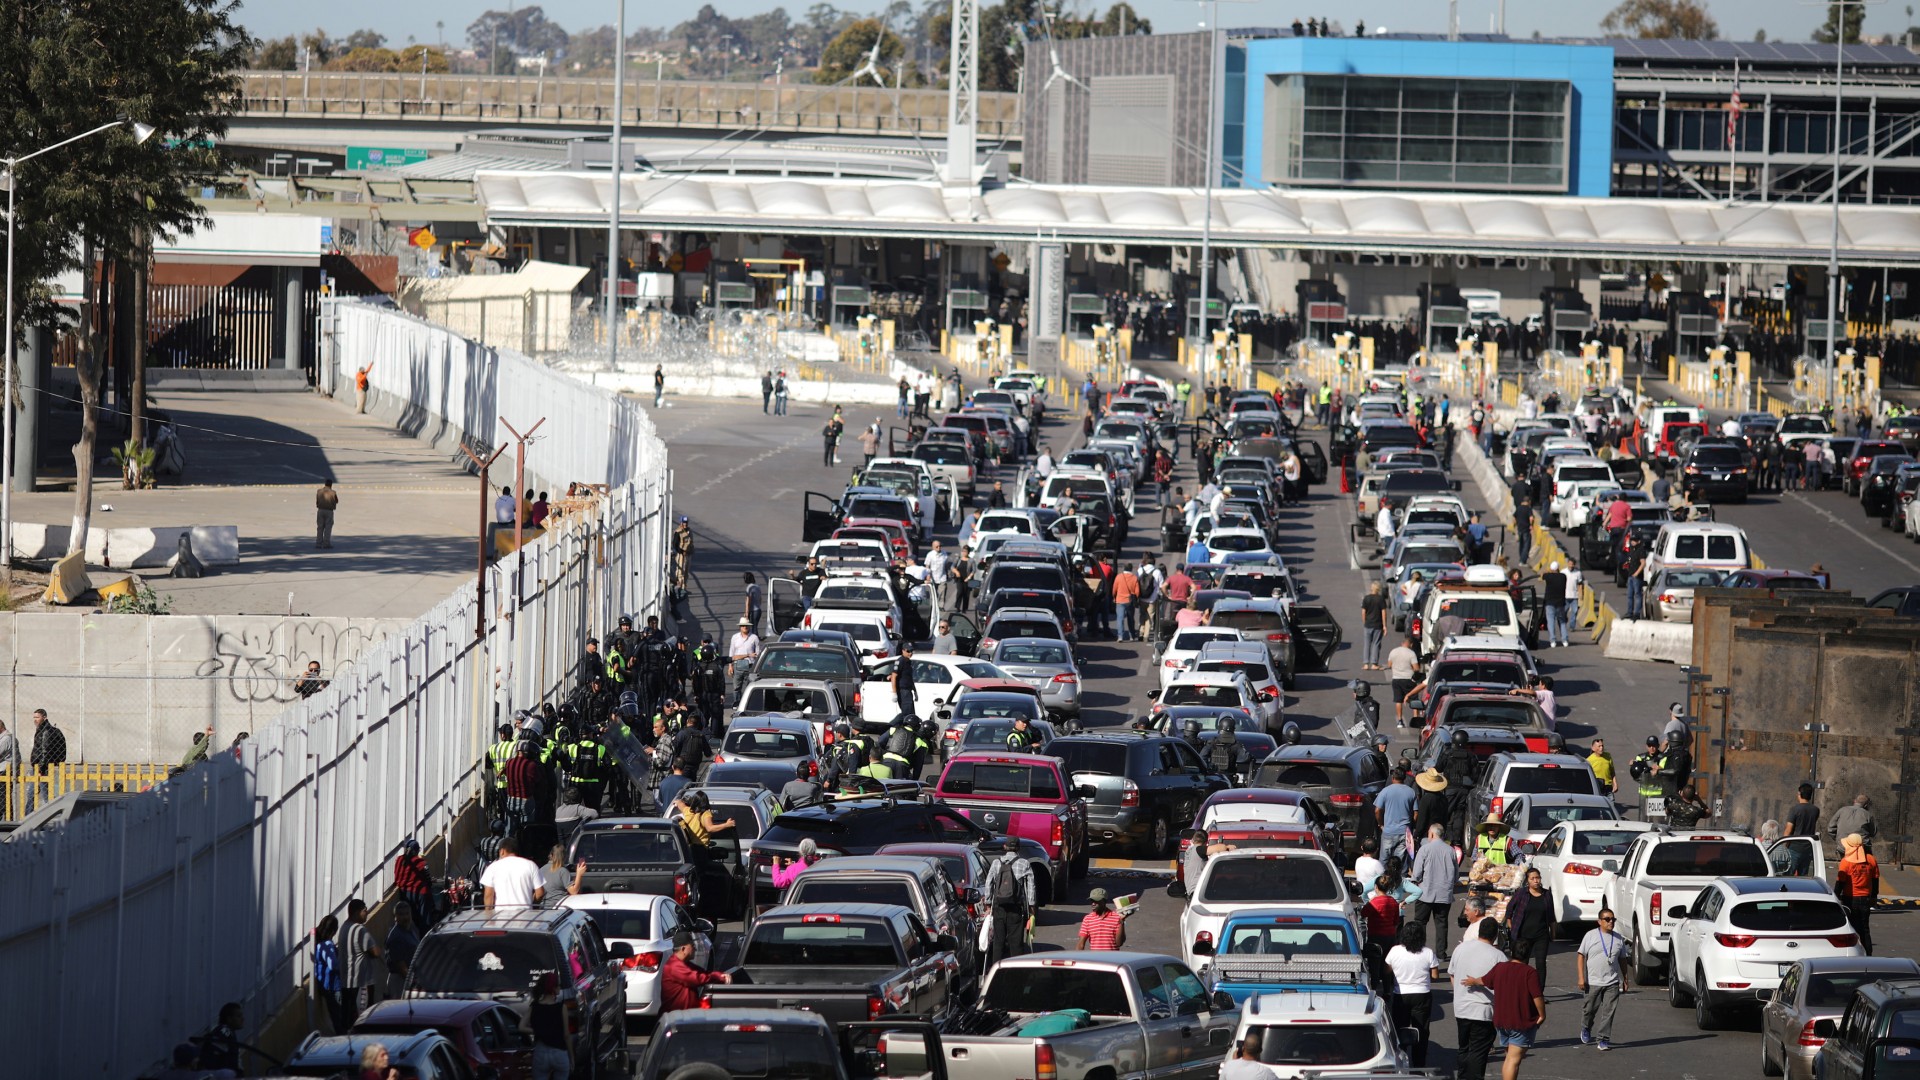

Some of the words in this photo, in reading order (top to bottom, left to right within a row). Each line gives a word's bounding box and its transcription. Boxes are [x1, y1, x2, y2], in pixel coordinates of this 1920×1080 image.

[1270, 249, 1325, 264] SAN
[1352, 252, 1468, 269] YSIDRO
[1494, 256, 1573, 271] PORT
